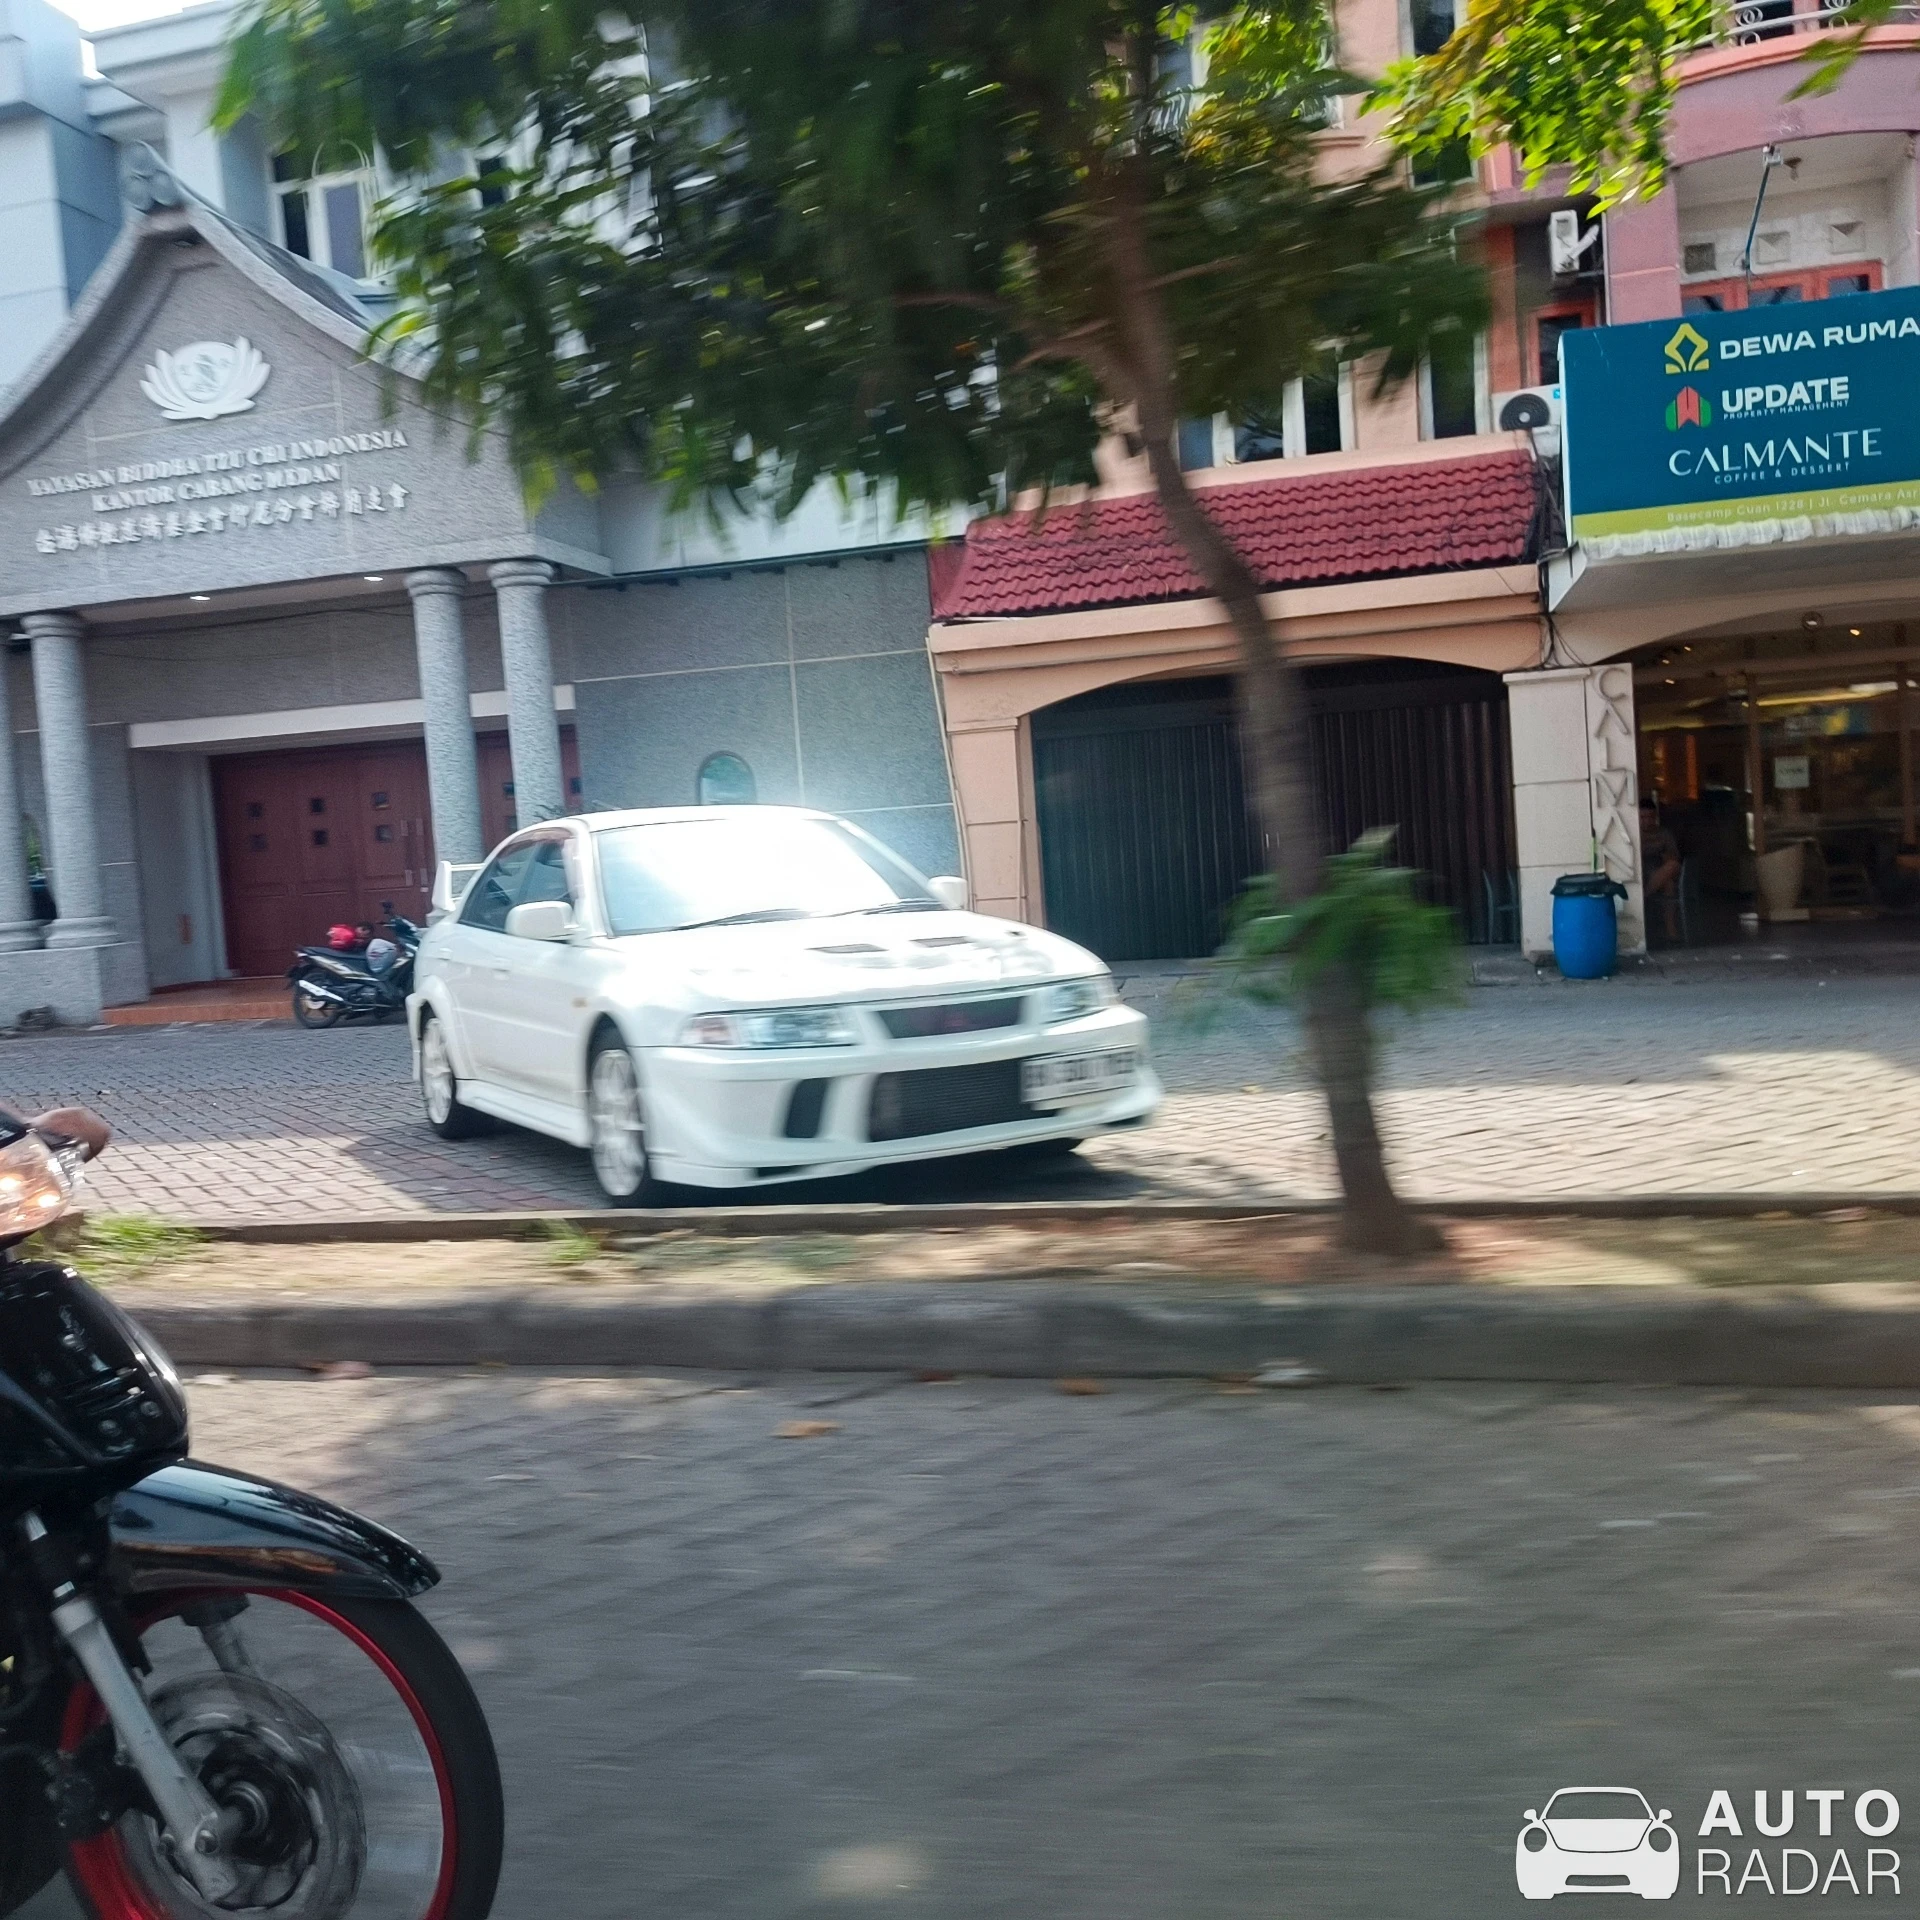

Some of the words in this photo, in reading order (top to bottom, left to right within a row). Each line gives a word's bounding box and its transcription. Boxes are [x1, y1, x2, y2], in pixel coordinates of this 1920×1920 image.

[1719, 330, 1816, 360] DEWA
[1823, 316, 1920, 347] RUMA
[1721, 376, 1850, 413] UPDATE
[1723, 408, 1775, 421] PROPERTY
[1779, 400, 1849, 414] MANAGEMENT
[289, 429, 409, 460] INDONESIA
[1668, 427, 1882, 476] CALMANTE
[1714, 471, 1766, 485] COFFEE
[1791, 461, 1850, 477] DESSERT
[1593, 667, 1639, 945] CALMAN
